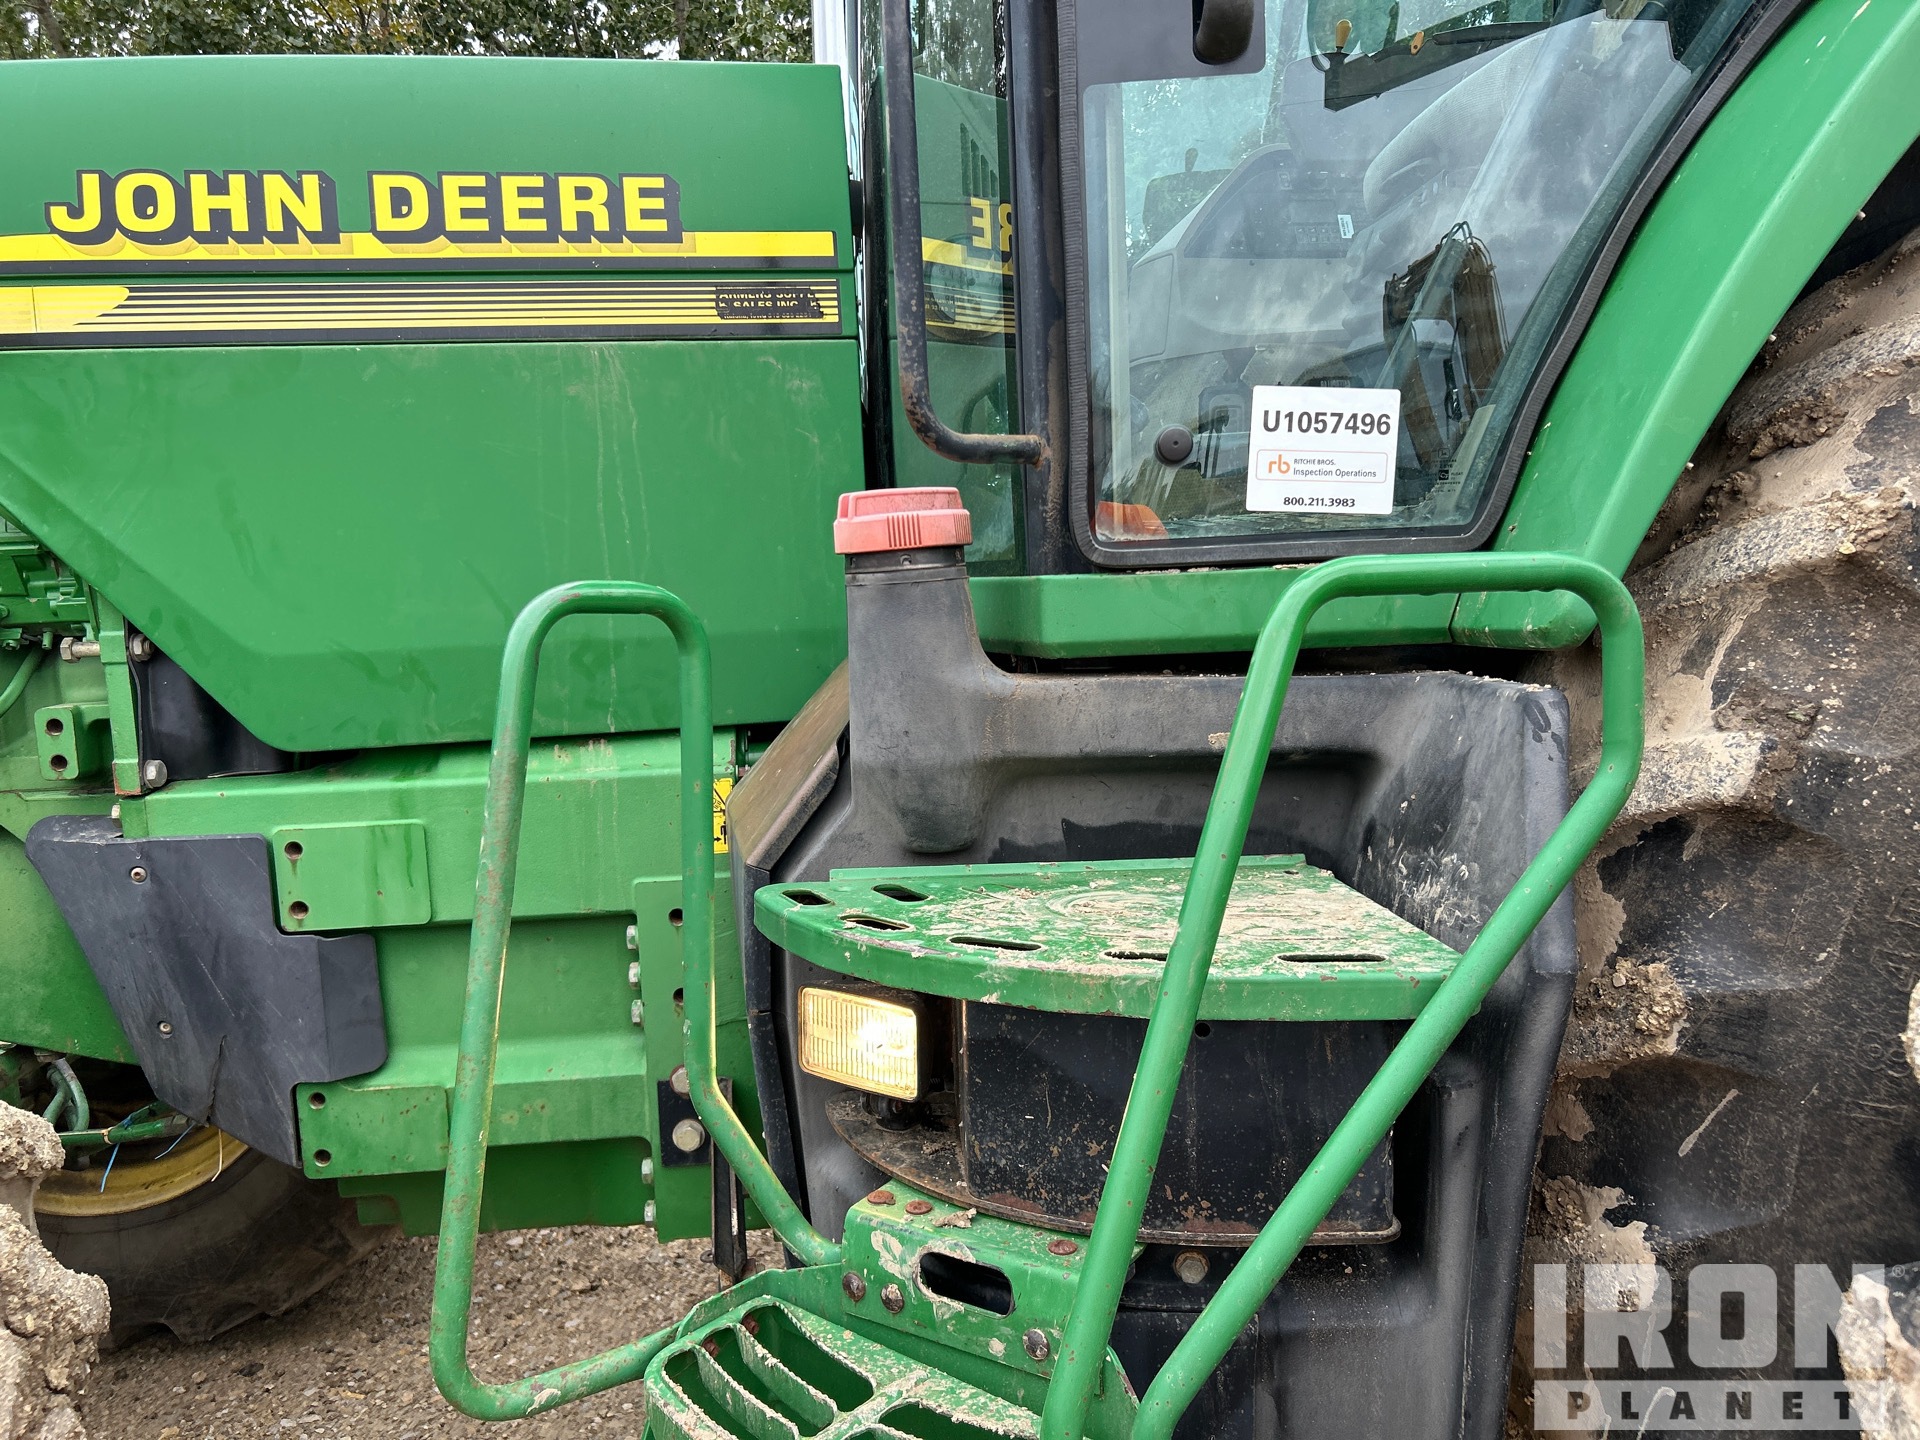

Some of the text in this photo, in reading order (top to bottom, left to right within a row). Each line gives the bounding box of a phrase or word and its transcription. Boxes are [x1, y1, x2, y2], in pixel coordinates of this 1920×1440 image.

[47, 170, 679, 241] JOHN DEERE
[1263, 410, 1391, 436] U1057496
[1268, 454, 1291, 475] rb
[1293, 458, 1316, 466] RITCHIE
[1293, 467, 1377, 478] Inspection Operations
[1283, 496, 1356, 508] 800.211.3983
